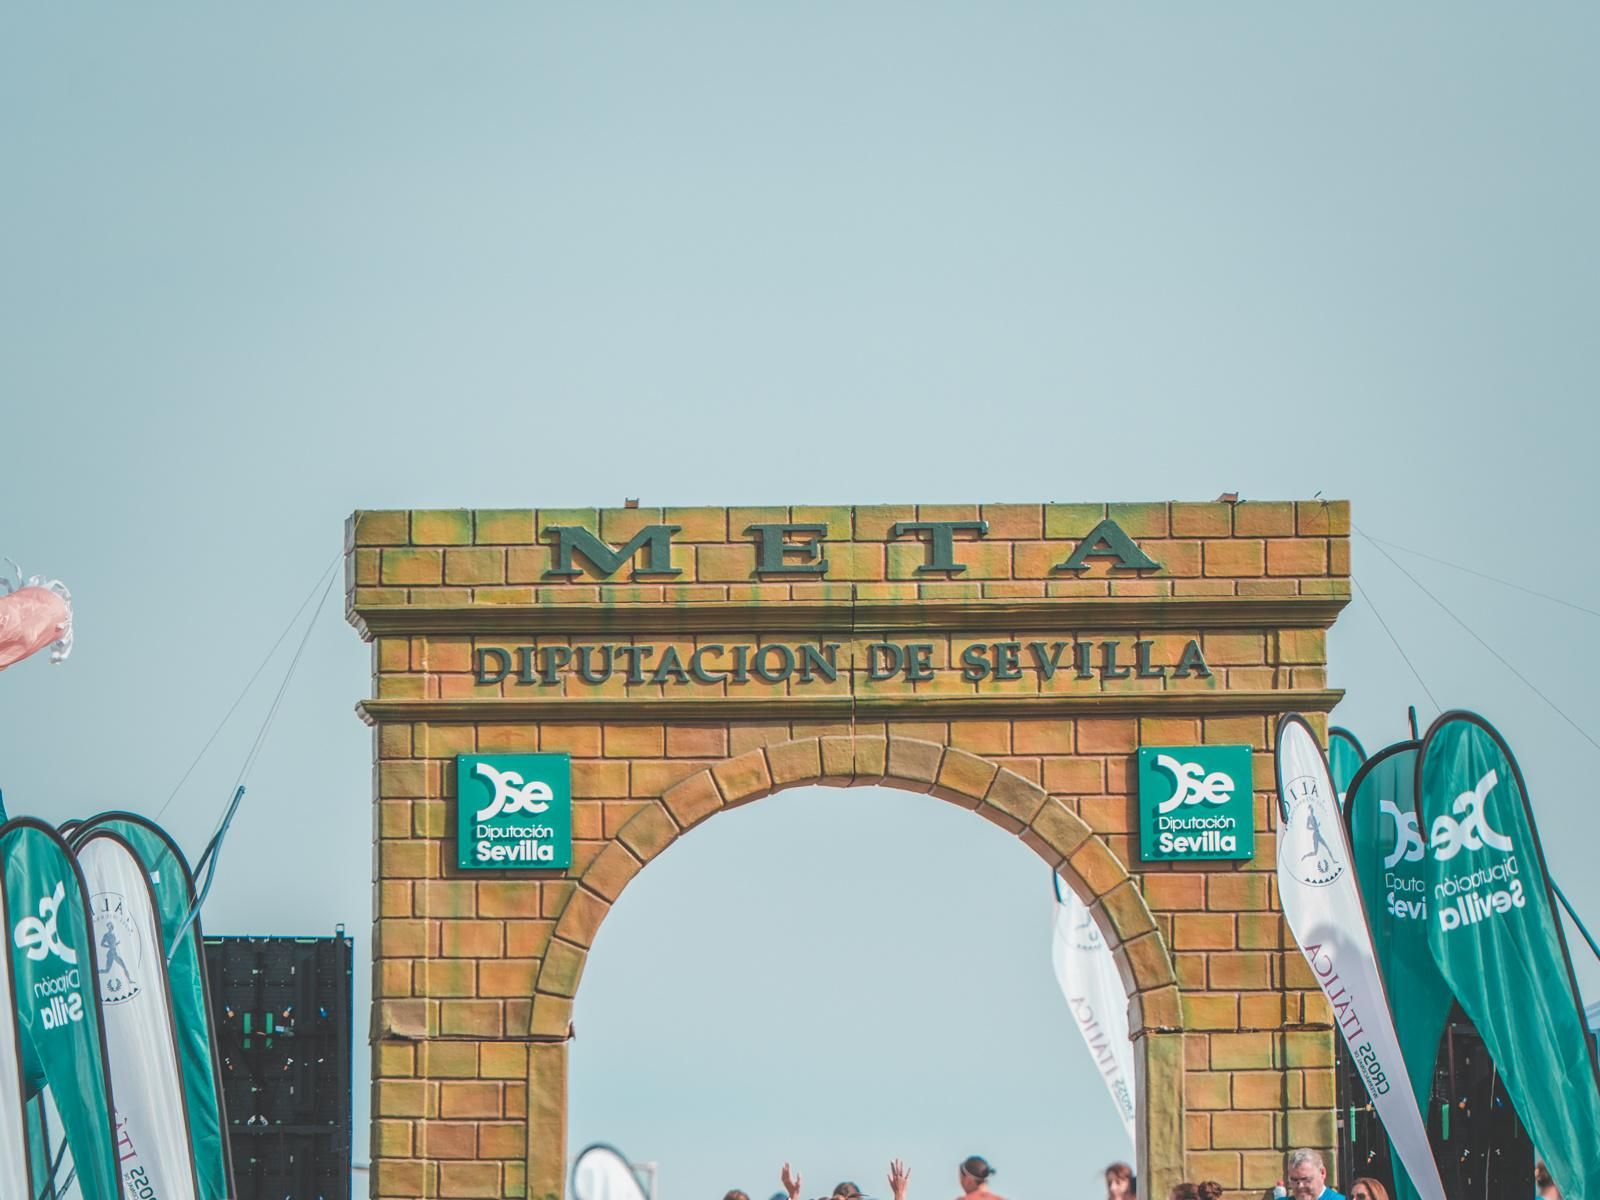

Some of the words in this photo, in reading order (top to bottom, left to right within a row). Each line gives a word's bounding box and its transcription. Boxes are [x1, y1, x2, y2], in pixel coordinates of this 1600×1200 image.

[543, 519, 1163, 576] META
[475, 643, 840, 686] DIPUTACION
[869, 642, 935, 682] DE
[963, 639, 1212, 682] SEVILLA
[476, 824, 554, 842] Diputación
[1158, 815, 1236, 834] Diputación
[476, 841, 554, 861] Sevilla
[1158, 832, 1237, 852] Sevilla
[1387, 892, 1428, 920] Sevi
